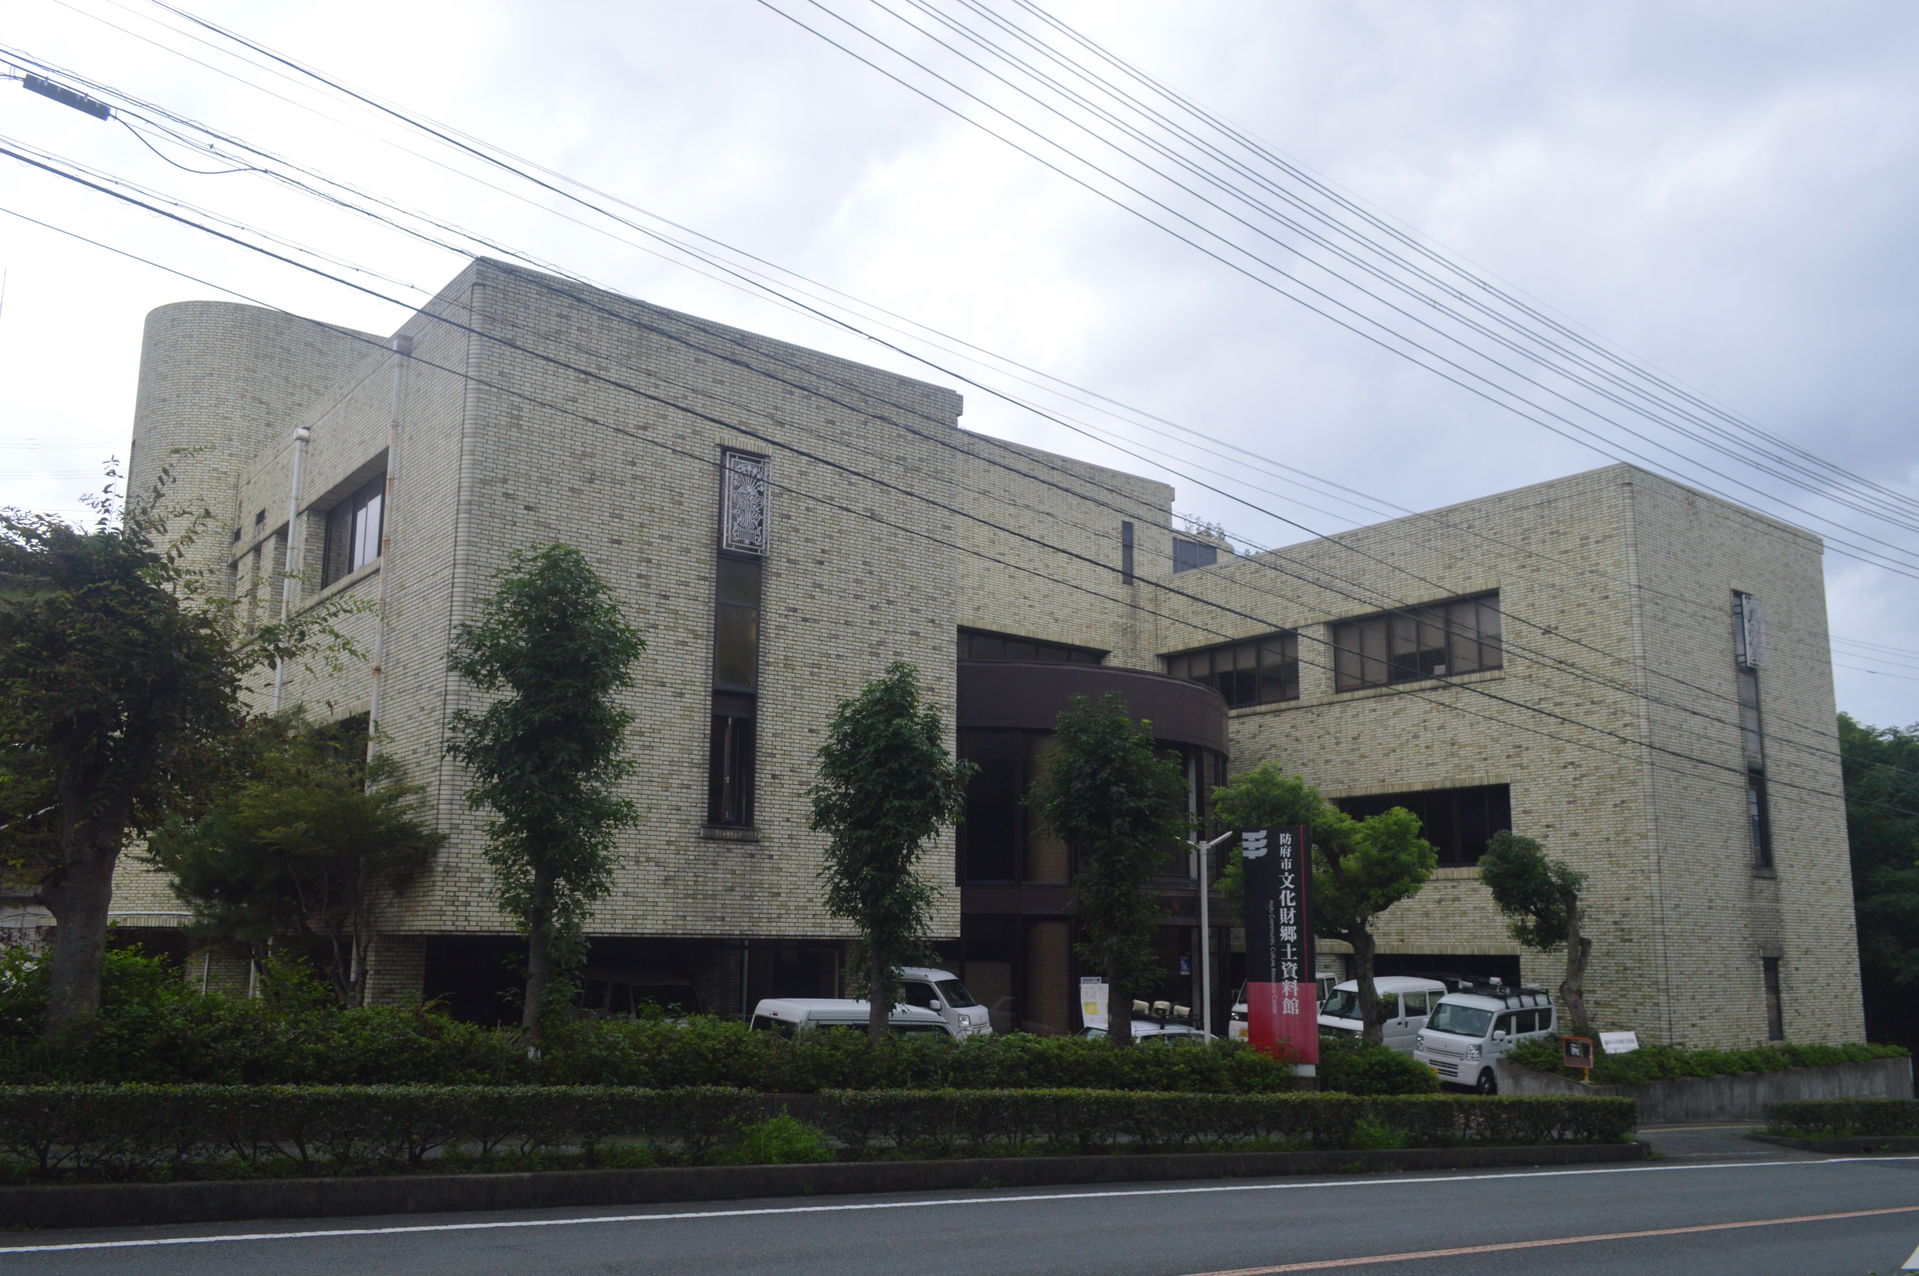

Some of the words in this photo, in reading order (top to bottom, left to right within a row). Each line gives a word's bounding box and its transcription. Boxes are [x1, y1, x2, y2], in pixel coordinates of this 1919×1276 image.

[1279, 832, 1299, 1015] 防府市文化財郷土資料館
